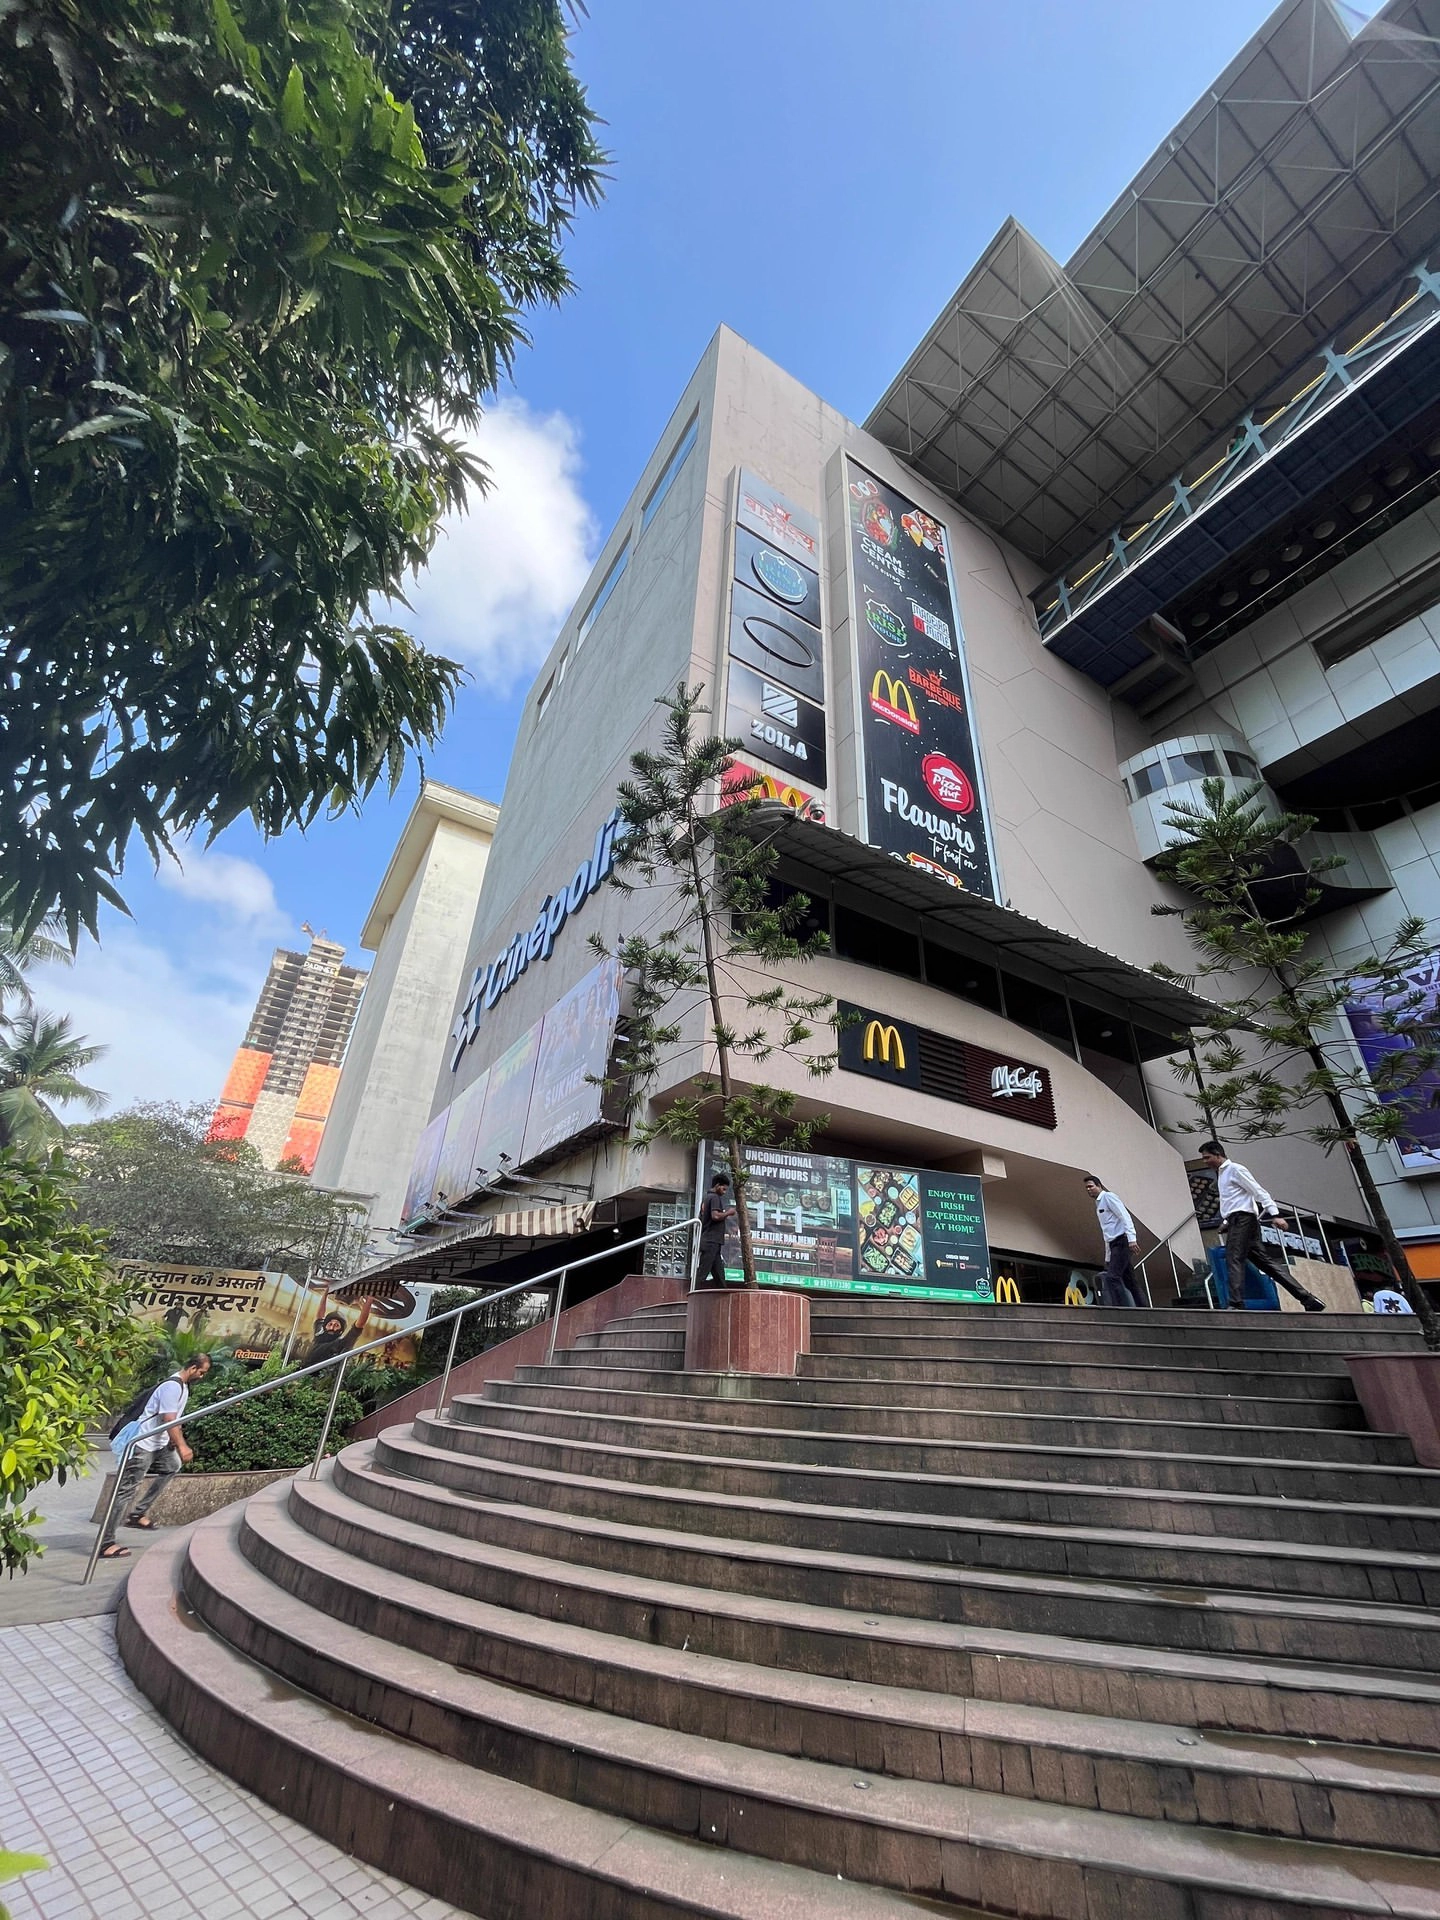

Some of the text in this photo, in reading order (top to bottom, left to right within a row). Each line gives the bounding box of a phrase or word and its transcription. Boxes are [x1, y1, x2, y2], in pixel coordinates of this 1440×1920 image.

[860, 543, 906, 578] CENTRE
[862, 537, 902, 568] CREAM
[865, 609, 907, 641] IRISH
[877, 608, 895, 624] THE
[872, 621, 902, 644] HOUSE
[908, 667, 961, 708] BARBEQUE
[925, 689, 949, 707] NATION
[872, 700, 918, 730] McDonald's
[751, 719, 808, 760] ZOILA
[933, 773, 962, 791] Pizza
[939, 787, 961, 800] Hut
[881, 777, 975, 853] Flavors
[928, 837, 978, 870] to feast on
[745, 1149, 813, 1169] UNCONDITIONAL
[749, 1164, 809, 1182] HAPPY HOURS
[927, 1189, 976, 1202] ENJOY THE
[940, 1201, 965, 1211] IRISH
[926, 1210, 981, 1223] EXPERIENCE
[750, 1229, 760, 1240] HE
[761, 1230, 783, 1242] ENTIRE
[934, 1222, 975, 1234] AT HOME
[752, 1247, 764, 1256] ERY
[783, 1250, 791, 1259] PM
[800, 1252, 809, 1260] PM
[216, 1276, 267, 1291] असली
